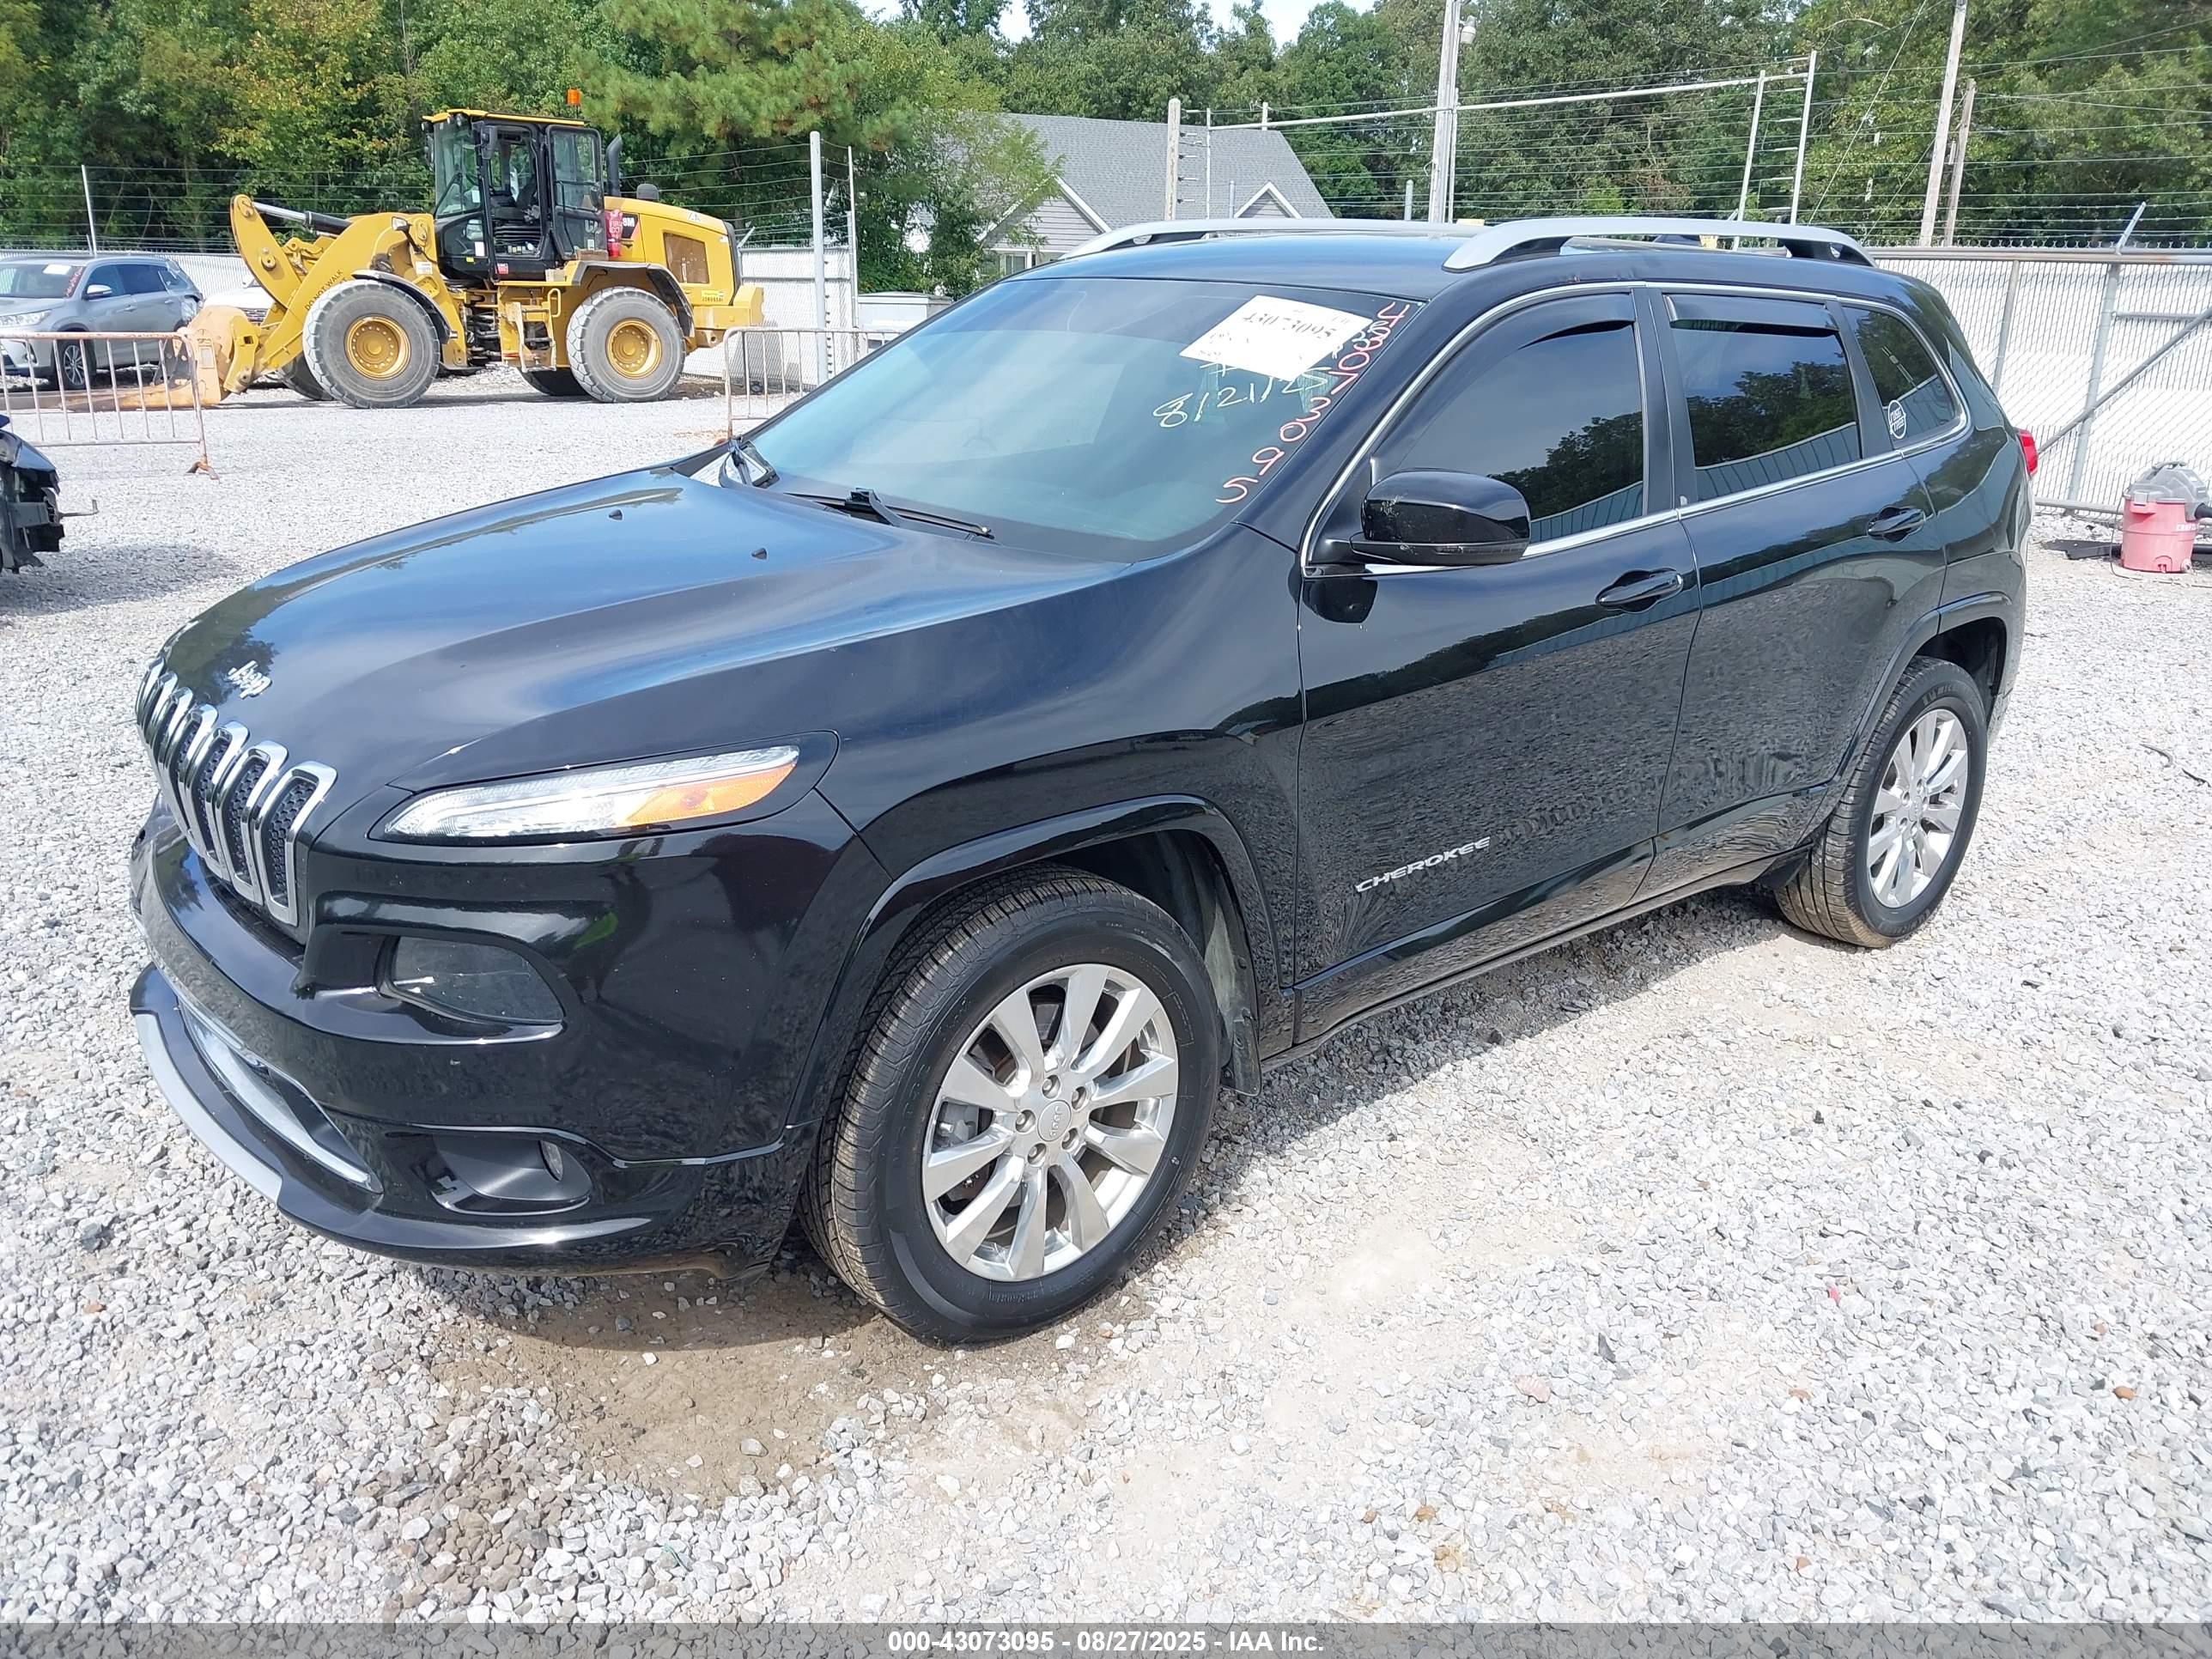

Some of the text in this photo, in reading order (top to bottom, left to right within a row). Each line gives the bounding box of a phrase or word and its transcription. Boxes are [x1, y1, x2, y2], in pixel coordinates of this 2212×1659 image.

[304, 298, 315, 311] DO
[314, 286, 328, 301] NOT
[326, 269, 343, 287] WALK
[1355, 836, 1492, 893] CHEROKEE
